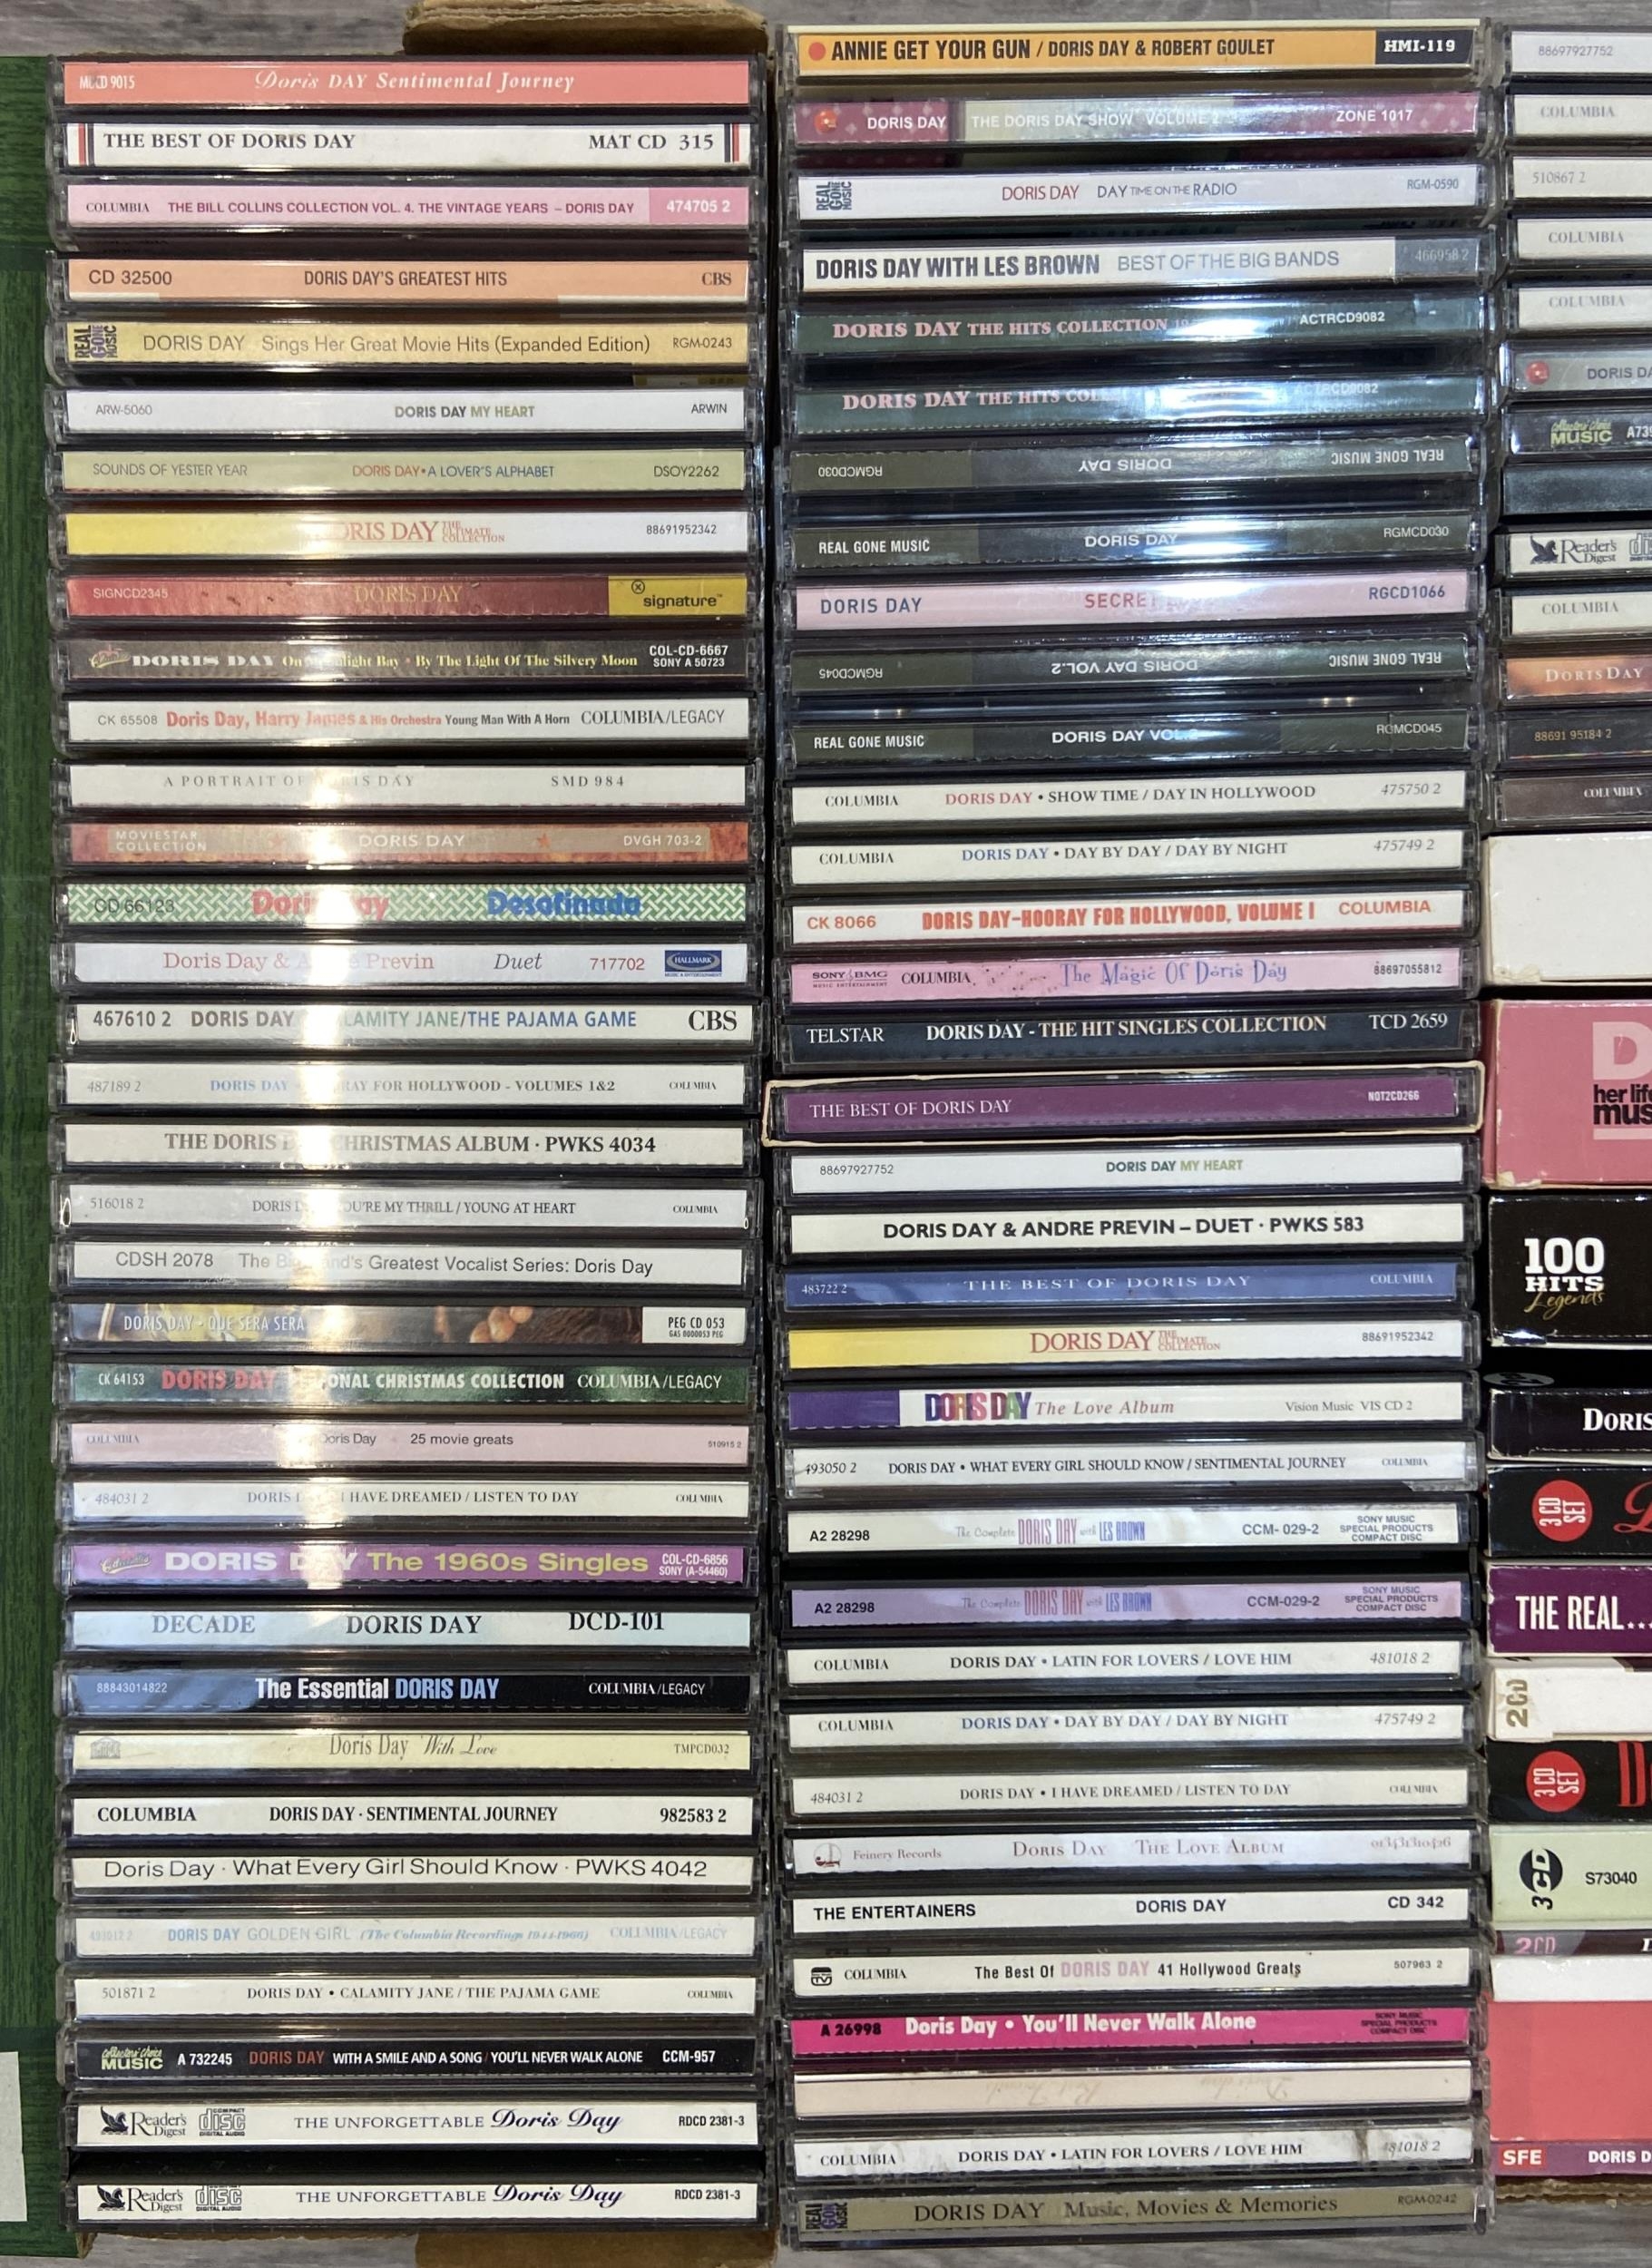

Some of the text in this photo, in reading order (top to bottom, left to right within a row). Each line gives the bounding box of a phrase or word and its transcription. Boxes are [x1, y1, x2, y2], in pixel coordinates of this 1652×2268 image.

[832, 41, 886, 61] ANNIE
[894, 40, 929, 60] GET
[936, 39, 986, 59] YOUR
[992, 39, 1031, 59] GUN
[1049, 41, 1094, 56] DORIS
[1099, 40, 1129, 56] DAY
[1152, 39, 1212, 55] ROBERT
[1217, 39, 1274, 55] GOULET
[1384, 40, 1455, 52] HMI-119
[256, 71, 573, 93] Doris DAY Sentimental Journey
[868, 116, 948, 129] DORIS DAY
[1336, 109, 1413, 122] ZONE 1017
[103, 134, 355, 148] THE BEST OF DORIS DAY
[590, 134, 713, 150] MAT CD 315
[667, 200, 717, 212] 474705
[816, 255, 1099, 279] DORIS DAY WITH LES BROWN
[1118, 250, 1339, 271] BEST OF THE BIG BANDS
[89, 270, 171, 285] CD 32500
[305, 271, 506, 286] DORIS DAY'S GREATEST HITS
[702, 272, 731, 285] CBS
[1300, 312, 1384, 326] ACTRCD9082
[143, 336, 244, 350] DORIS DAY
[263, 335, 650, 356] Sings Her Great Movie Hits (Expanded Edition)
[1588, 367, 1632, 379] DORIS
[96, 405, 152, 415] ARW-5060
[396, 406, 534, 417] DORIS DAY MY HEART
[1550, 430, 1613, 445] MUSIC
[93, 464, 247, 475] SOUNDS OF YESTER YEAR
[654, 466, 718, 477] DSOY2262
[817, 466, 882, 478] RGMCD030
[647, 524, 716, 534] 88691952342
[819, 540, 929, 553] REAL GONE MUSIC
[92, 588, 168, 601] SIGNCD2345
[1369, 585, 1444, 600] RGCD1066
[643, 593, 717, 609] signature
[821, 598, 922, 613] DORIS DAY
[650, 645, 728, 656] COL-CD-6667
[653, 658, 724, 668] SONY A 50723
[445, 714, 570, 726] Young Man With A Horn
[582, 709, 724, 724] COLUMBIA/LEGACY
[1339, 898, 1431, 914] COLUMBIA
[807, 915, 876, 929] CK 8066
[494, 953, 542, 969] Duet
[590, 958, 644, 971] 717702
[93, 1011, 155, 1027] 467610
[689, 1011, 737, 1031] CBS
[806, 1027, 884, 1043] TELSTAR
[1593, 1084, 1628, 1104] her
[809, 1100, 1011, 1118] THE BEST OF DORIS DAY
[1524, 1237, 1605, 1275] 100
[1525, 1276, 1605, 1293] HITS
[1522, 1287, 1606, 1321] Legends
[669, 1317, 724, 1328] PEG CD 053
[1285, 1402, 1318, 1412] Vision
[1323, 1402, 1354, 1411] Music
[1361, 1401, 1381, 1411] VIS
[1384, 1401, 1403, 1410] CD
[411, 1433, 513, 1447] 25 movie greats
[1539, 1497, 1563, 1528] 3 CD
[1562, 1500, 1587, 1524] SET
[810, 1530, 869, 1541] A2 28298
[662, 1554, 728, 1565] COL-CD-6856
[1515, 1596, 1625, 1630] THE REAL
[152, 1615, 255, 1633] DECADE
[347, 1616, 481, 1634] DORIS DAY
[570, 1613, 663, 1630] DCD-101
[96, 1683, 168, 1693] 88843014822
[255, 1678, 500, 1699] The Essential DORIS DAY
[98, 1807, 196, 1822] COLUMBIA
[1586, 1872, 1637, 1884] S73040
[1388, 1896, 1443, 1909] CD 342
[814, 1904, 975, 1920] THE ENTERTAINERS
[663, 2050, 715, 2062] CCM-957
[295, 2109, 621, 2134] THE UNFORGETTABLE Doris Day
[1502, 2149, 1542, 2165] SFE
[1588, 2150, 1636, 2163] DORIS
[1138, 2198, 1208, 2215] Movies
[1241, 2195, 1337, 2214] Memories
